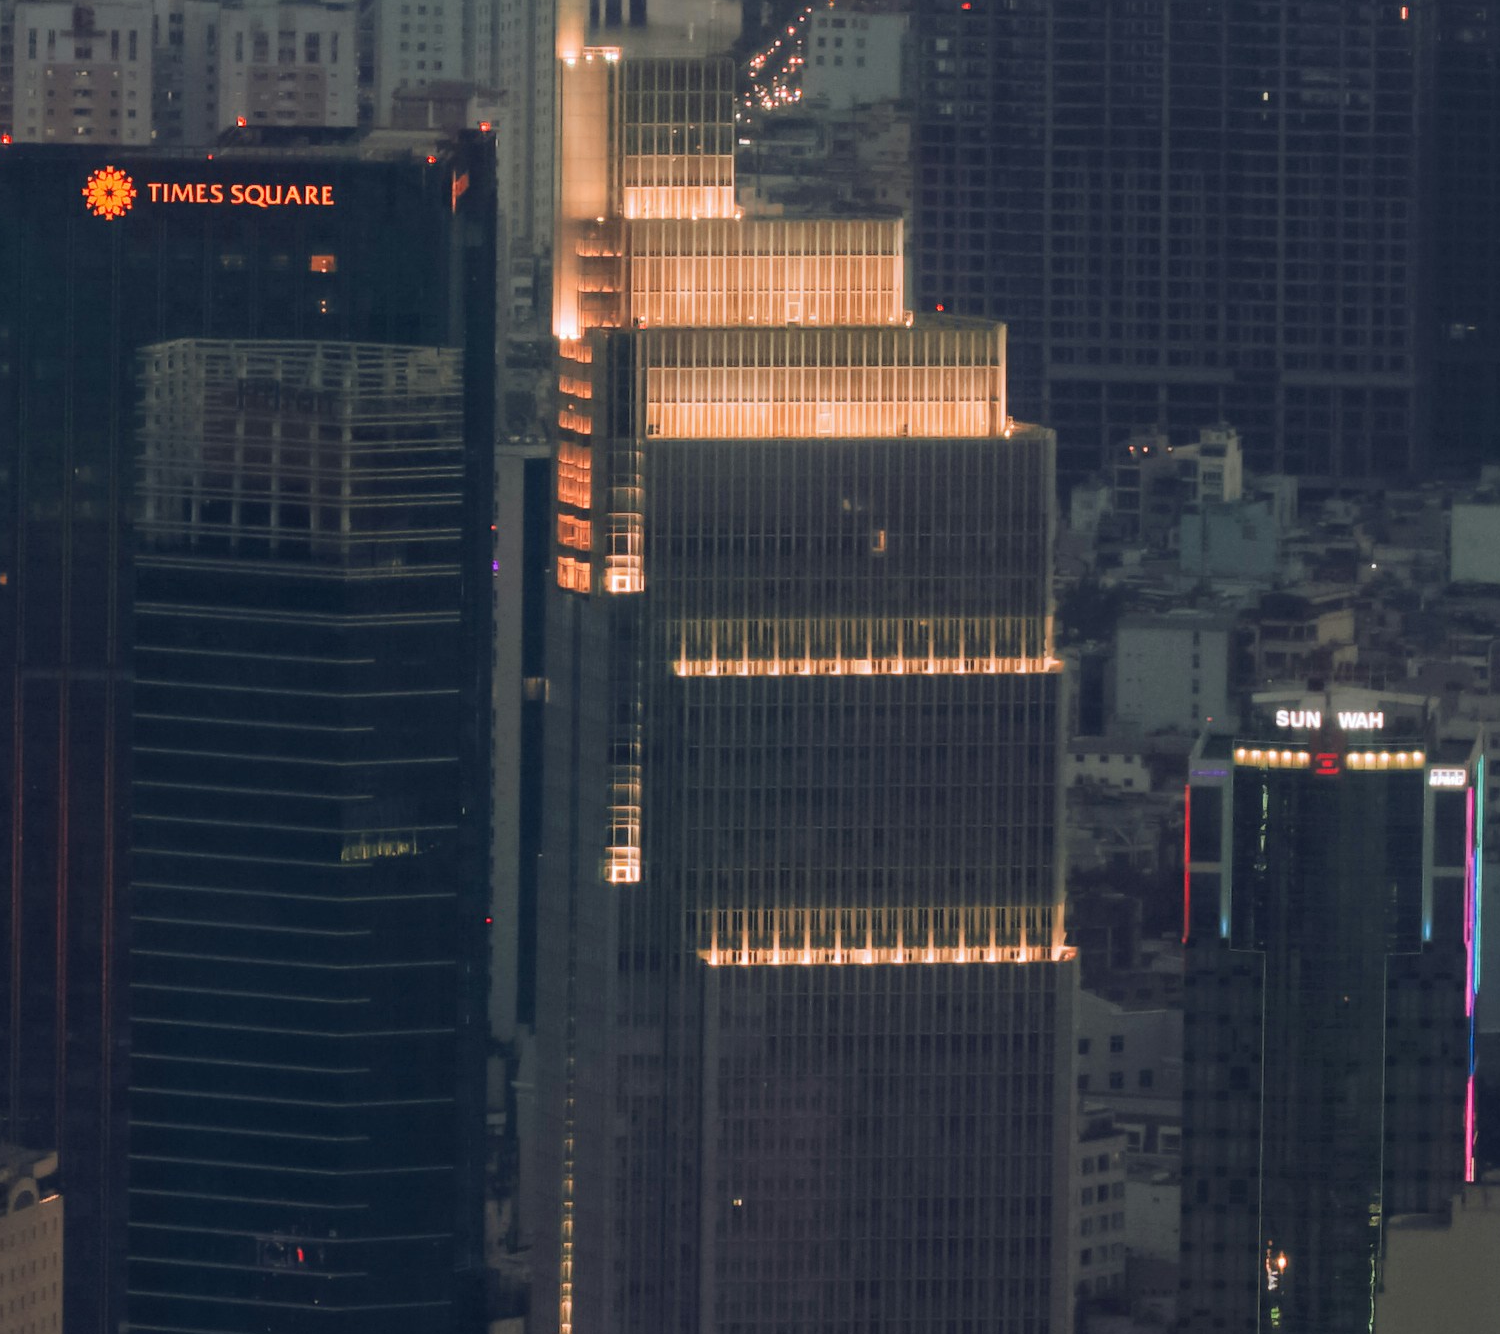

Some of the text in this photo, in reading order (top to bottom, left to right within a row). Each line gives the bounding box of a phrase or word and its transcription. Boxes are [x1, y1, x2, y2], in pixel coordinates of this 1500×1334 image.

[147, 183, 335, 208] TIMES SQUARE
[1276, 709, 1384, 730] SUN WAH
[1429, 768, 1467, 787] KPMG
